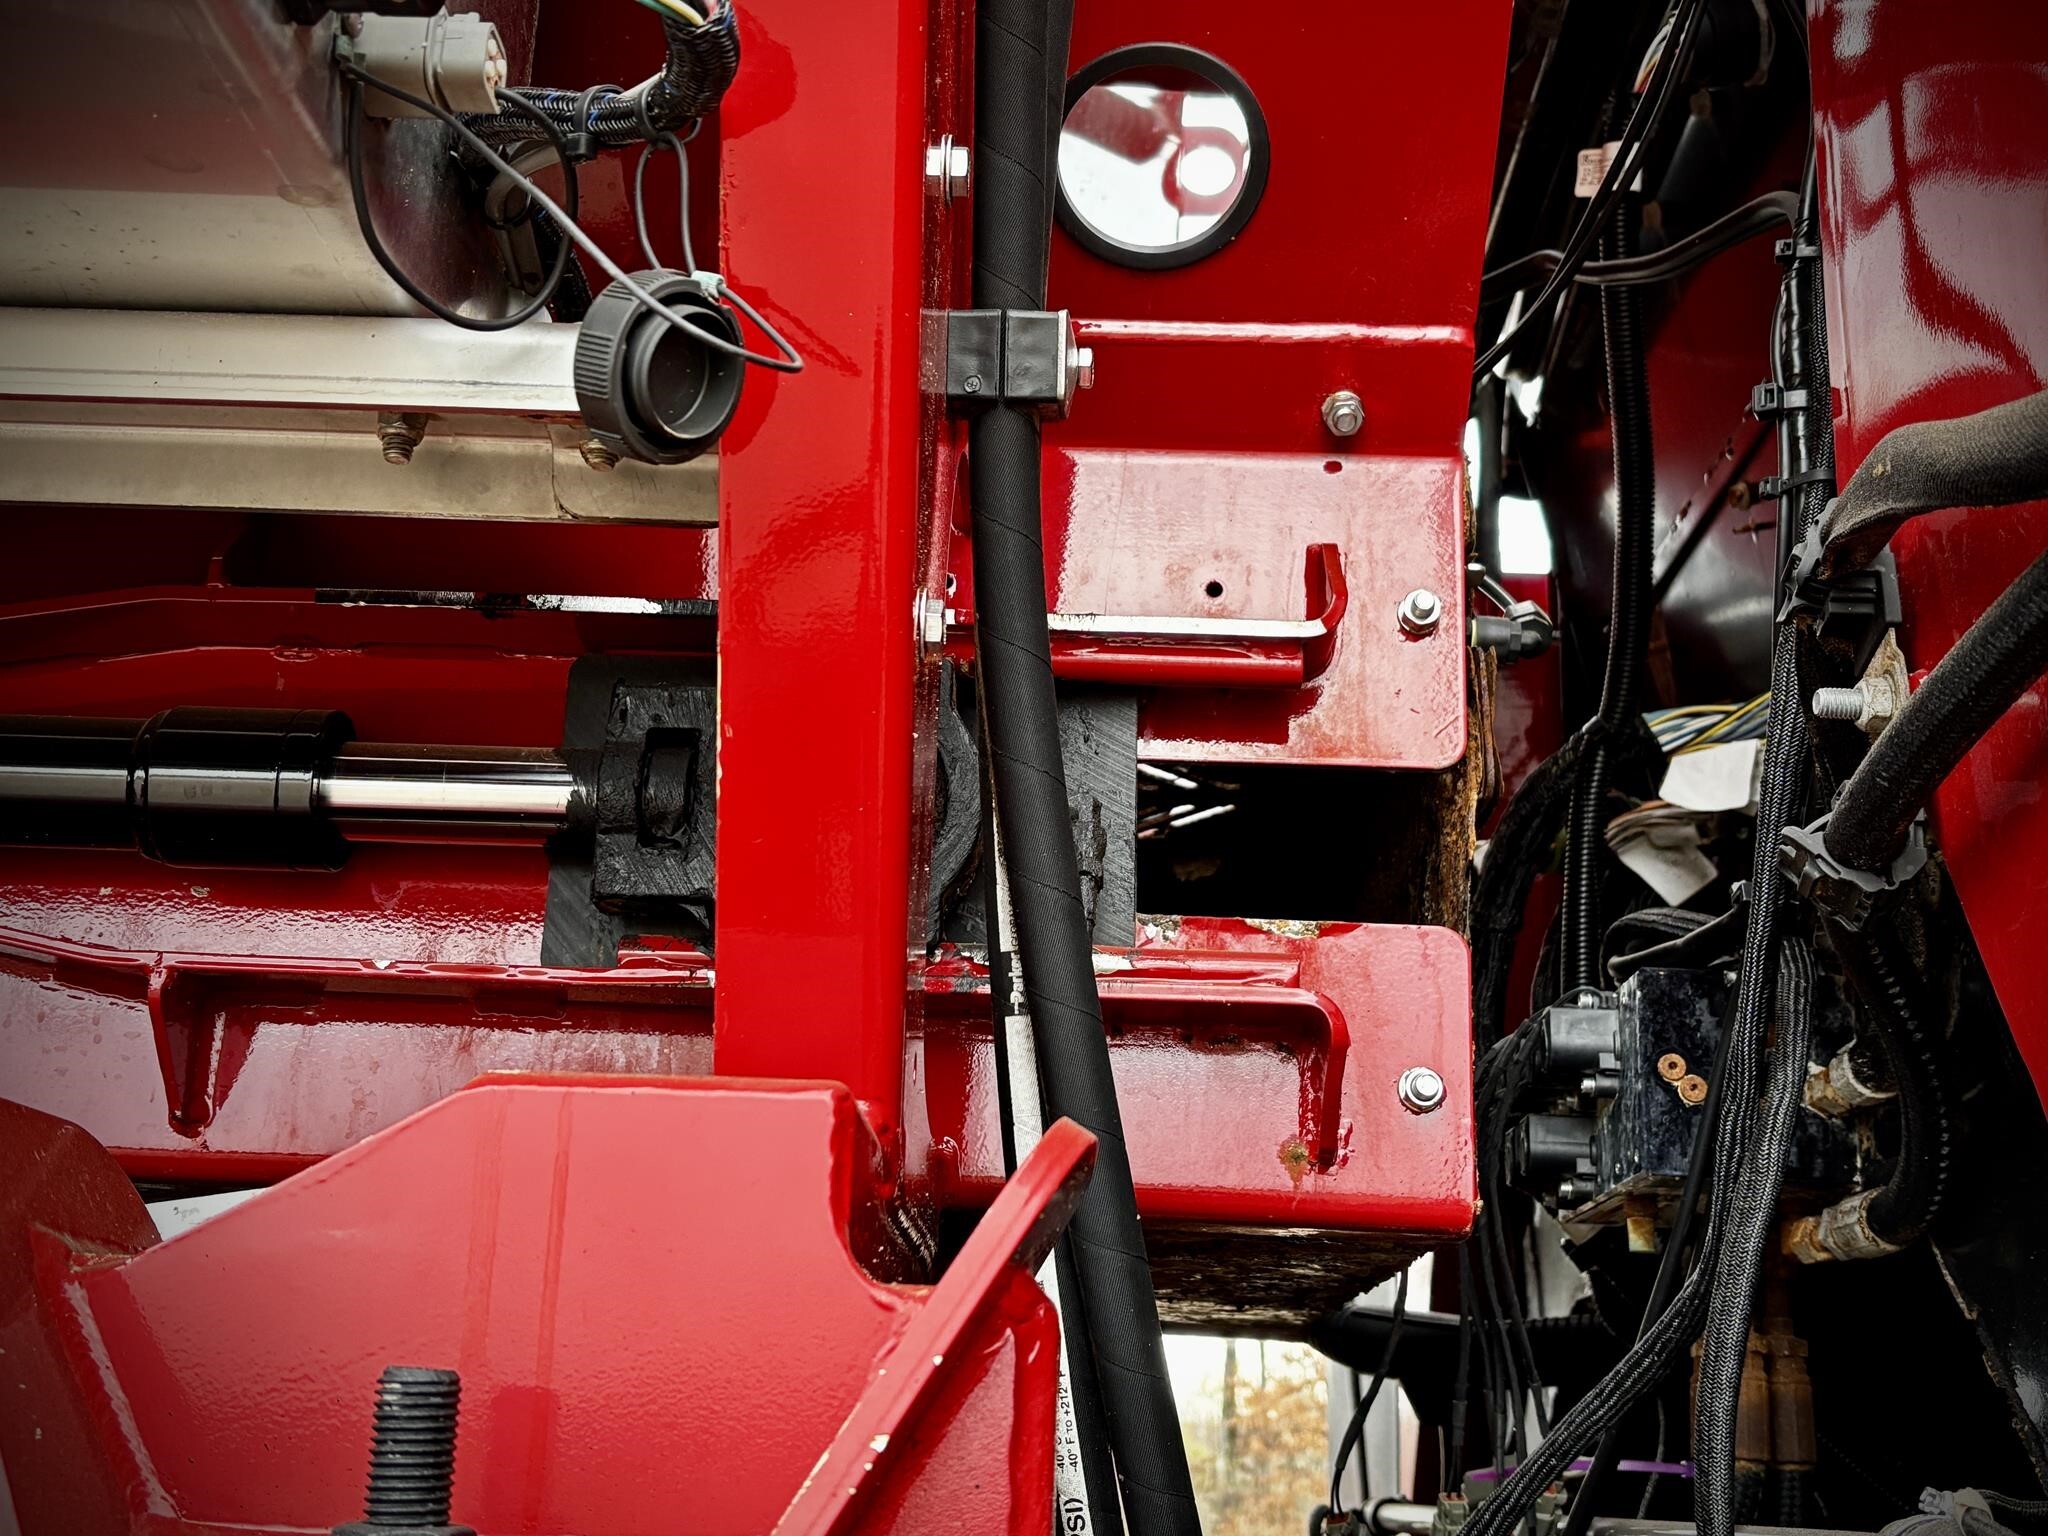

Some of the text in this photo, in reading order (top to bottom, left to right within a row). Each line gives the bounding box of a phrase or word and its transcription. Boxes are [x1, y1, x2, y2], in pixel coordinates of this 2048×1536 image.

[1008, 953, 1025, 1013] Parker
[1065, 1436, 1075, 1445] F
[1067, 1448, 1078, 1473] -40°
[1063, 1498, 1086, 1536] SI)
